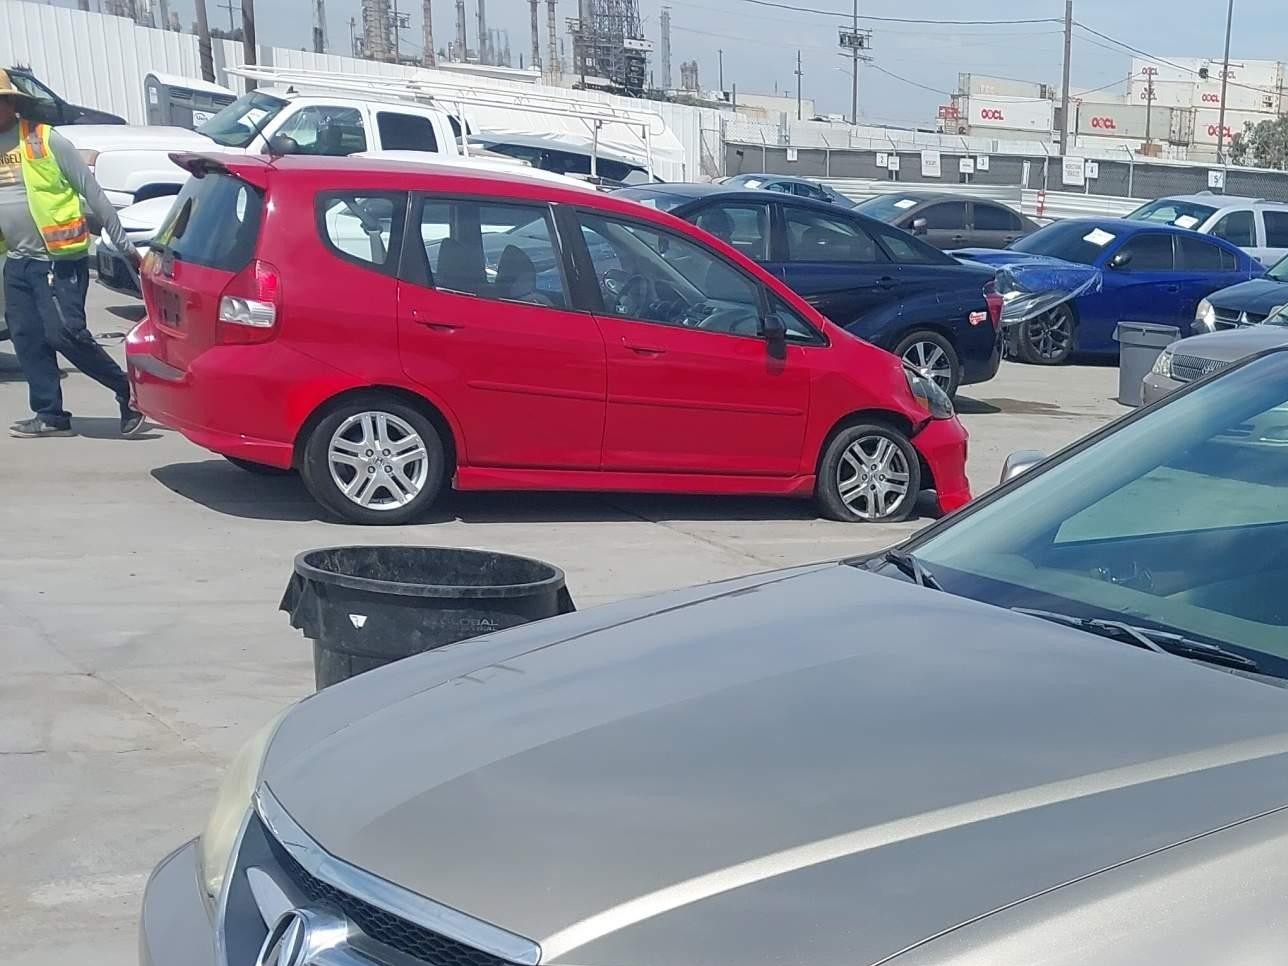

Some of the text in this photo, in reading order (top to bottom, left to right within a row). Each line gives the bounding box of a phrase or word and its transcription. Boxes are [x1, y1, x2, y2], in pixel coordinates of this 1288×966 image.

[1202, 94, 1220, 103] OOCL
[981, 109, 1004, 120] OOCL
[1092, 118, 1116, 129] OOCL
